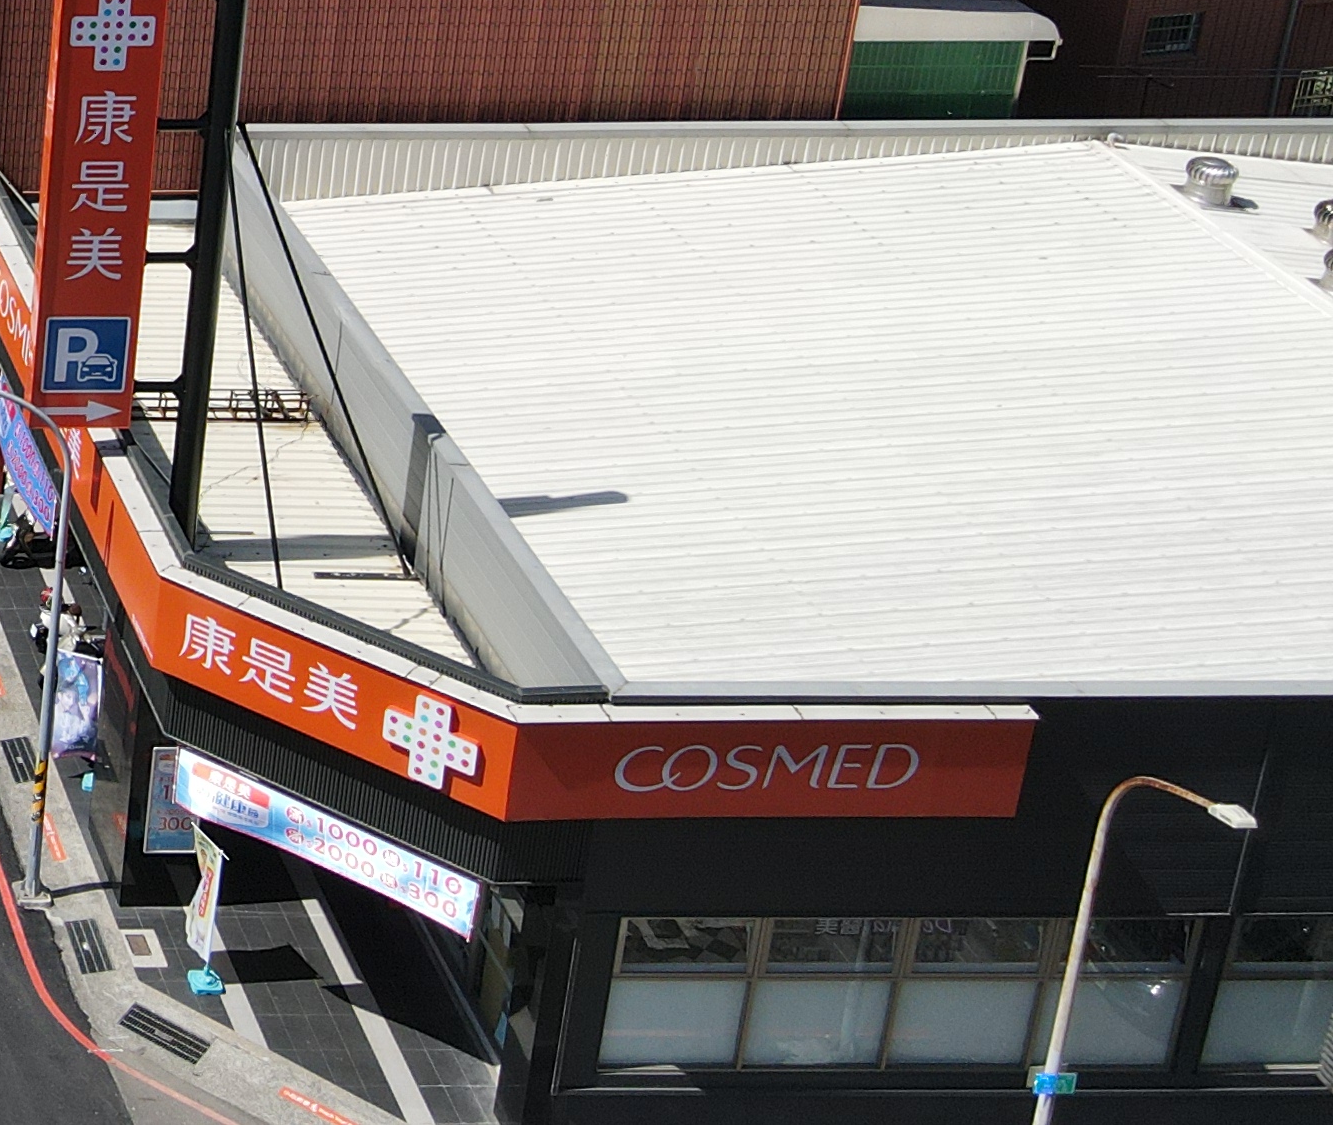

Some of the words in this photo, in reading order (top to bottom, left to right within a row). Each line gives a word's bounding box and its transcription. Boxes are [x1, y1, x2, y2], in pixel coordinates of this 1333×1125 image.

[65, 90, 137, 281] 康是美
[53, 327, 99, 383] P
[179, 612, 360, 731] 康是美
[613, 742, 921, 792] COSMED
